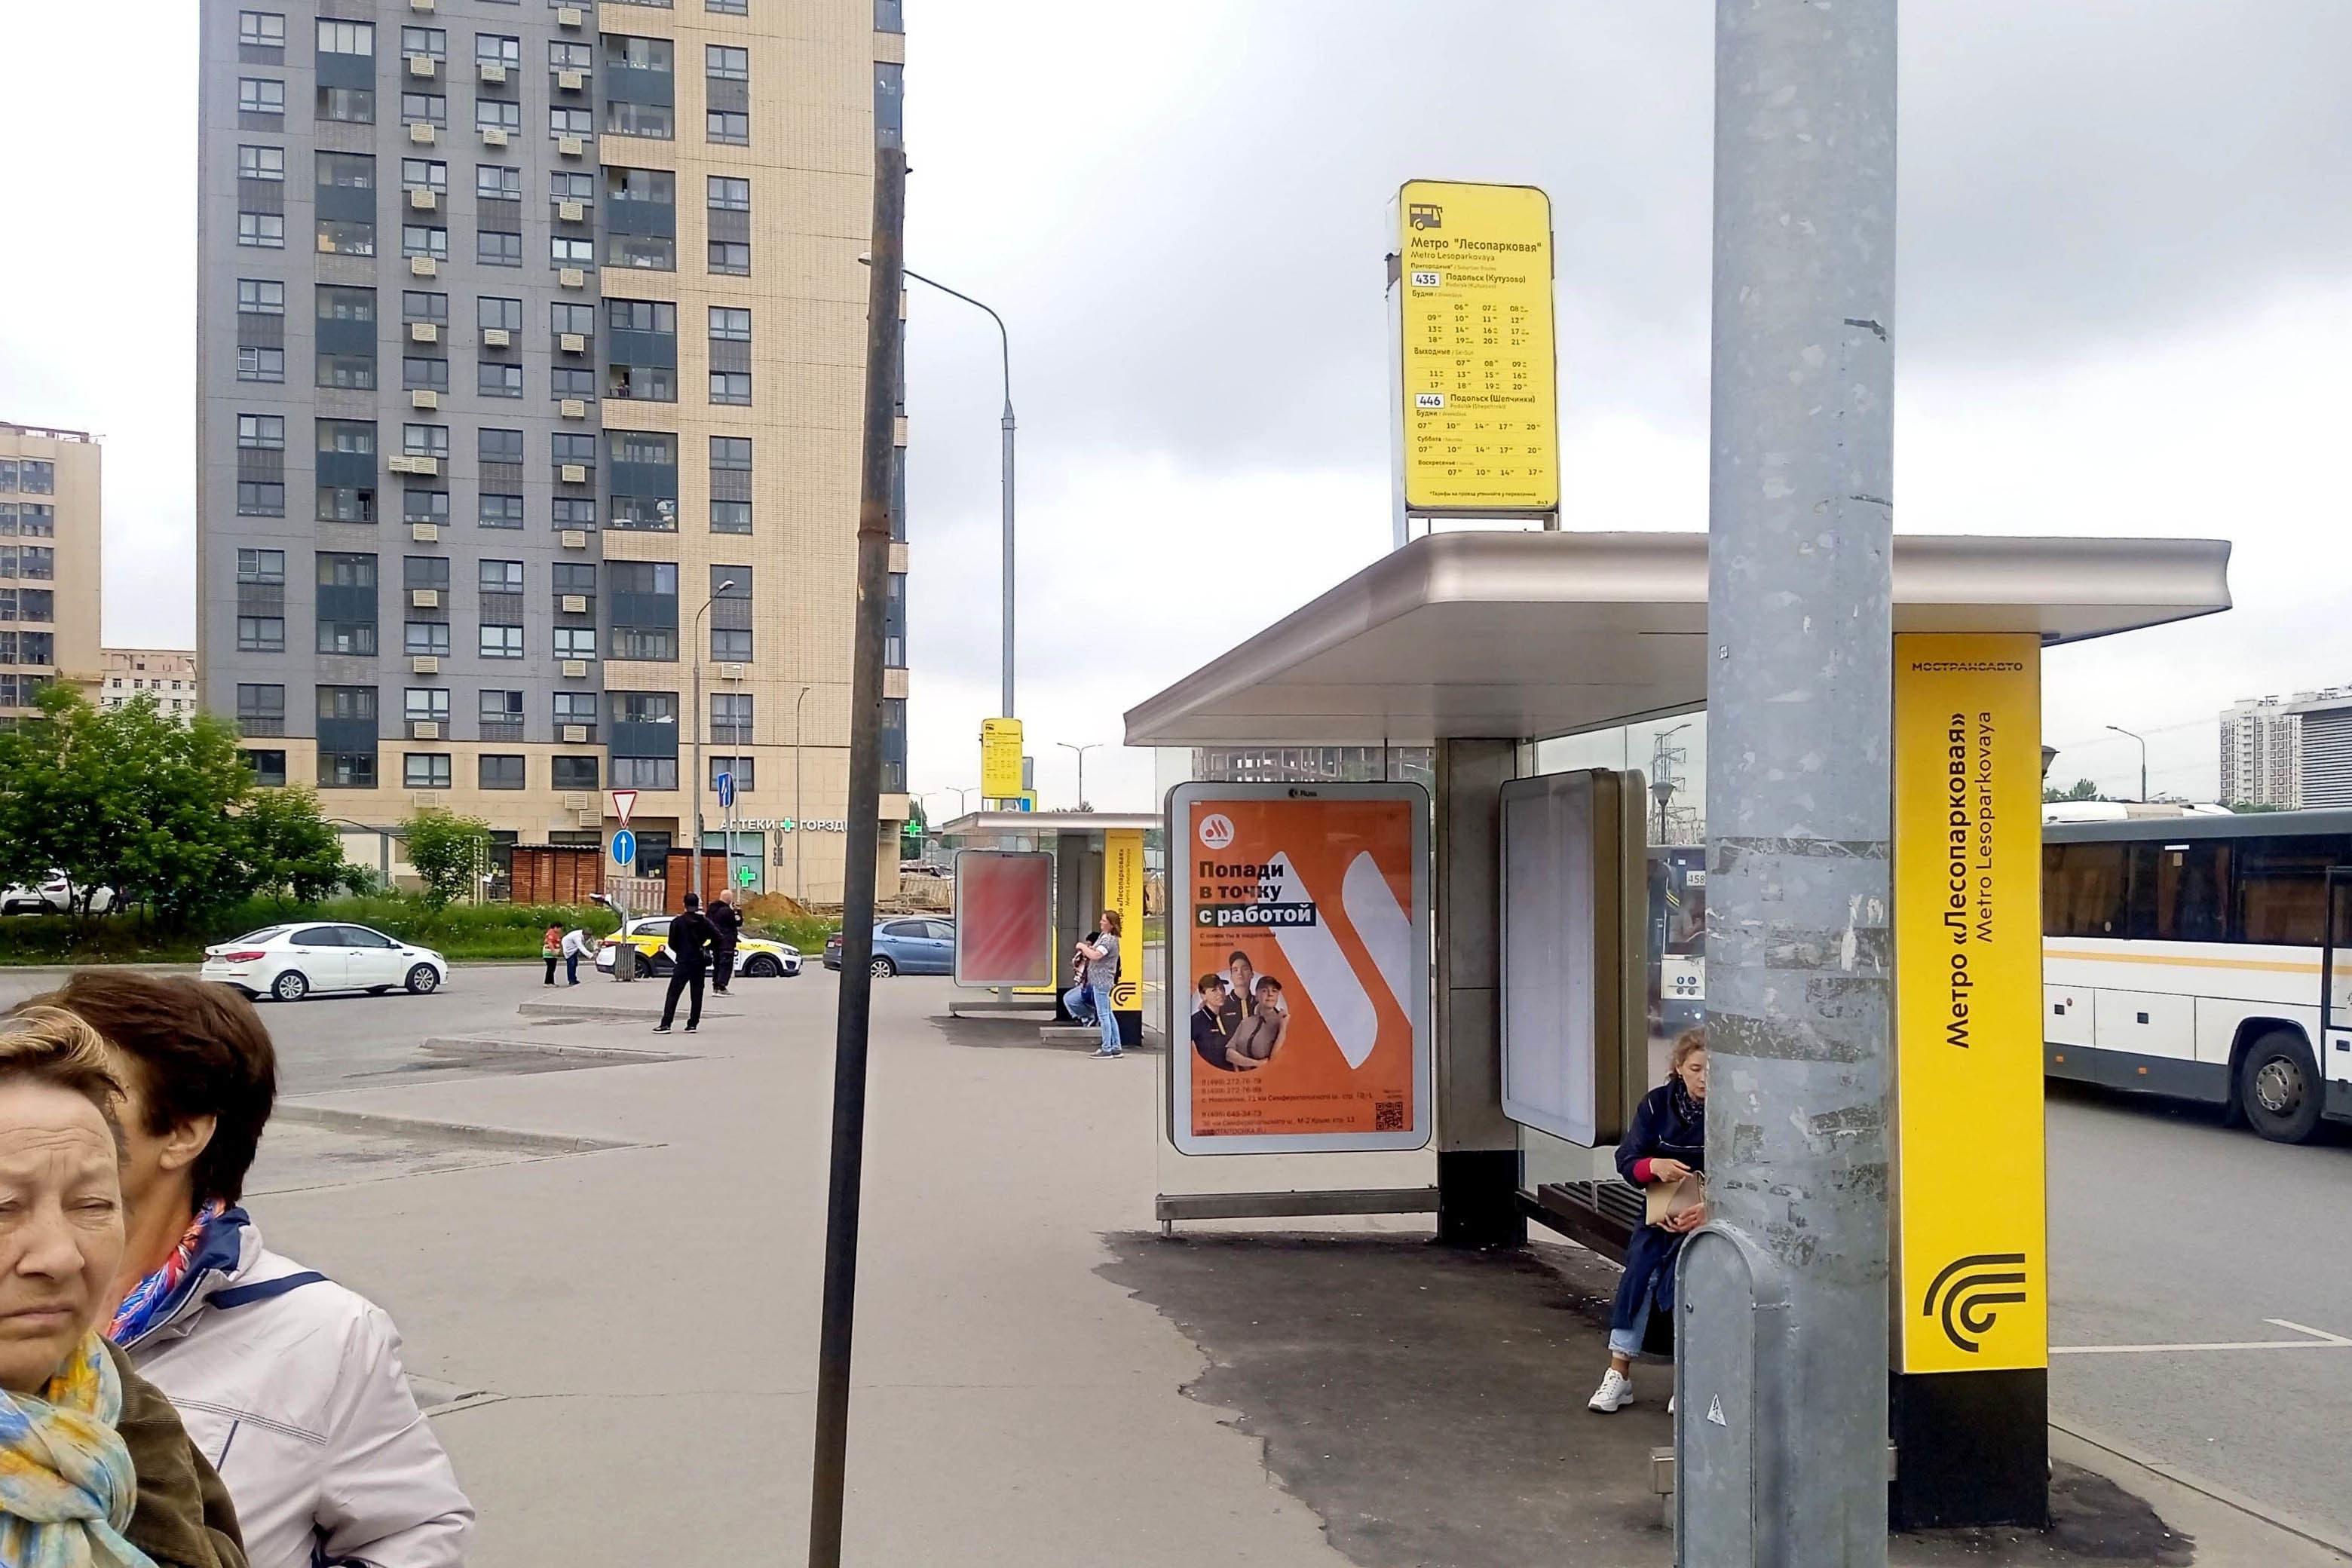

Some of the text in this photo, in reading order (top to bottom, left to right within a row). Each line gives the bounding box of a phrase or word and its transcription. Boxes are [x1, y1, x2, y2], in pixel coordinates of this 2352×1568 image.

[1411, 237, 1542, 253] Метро "Лесопарковая"
[1410, 251, 1496, 262] Metro Lesoparkovaya
[1416, 274, 1436, 285] 435
[1446, 273, 1526, 284] Подольск (Кутузово)
[1419, 396, 1441, 406] 446
[1450, 394, 1489, 403] Подольск
[800, 819, 847, 832] ГОРЗД
[1975, 711, 1995, 943] Metro Lesoparkovaya
[1199, 861, 1285, 879] Попади
[1688, 874, 1705, 884] 458
[1944, 713, 1974, 1049] Метро «Лесопарковая»
[1199, 884, 1282, 902] в точку
[1199, 903, 1311, 927] с работой
